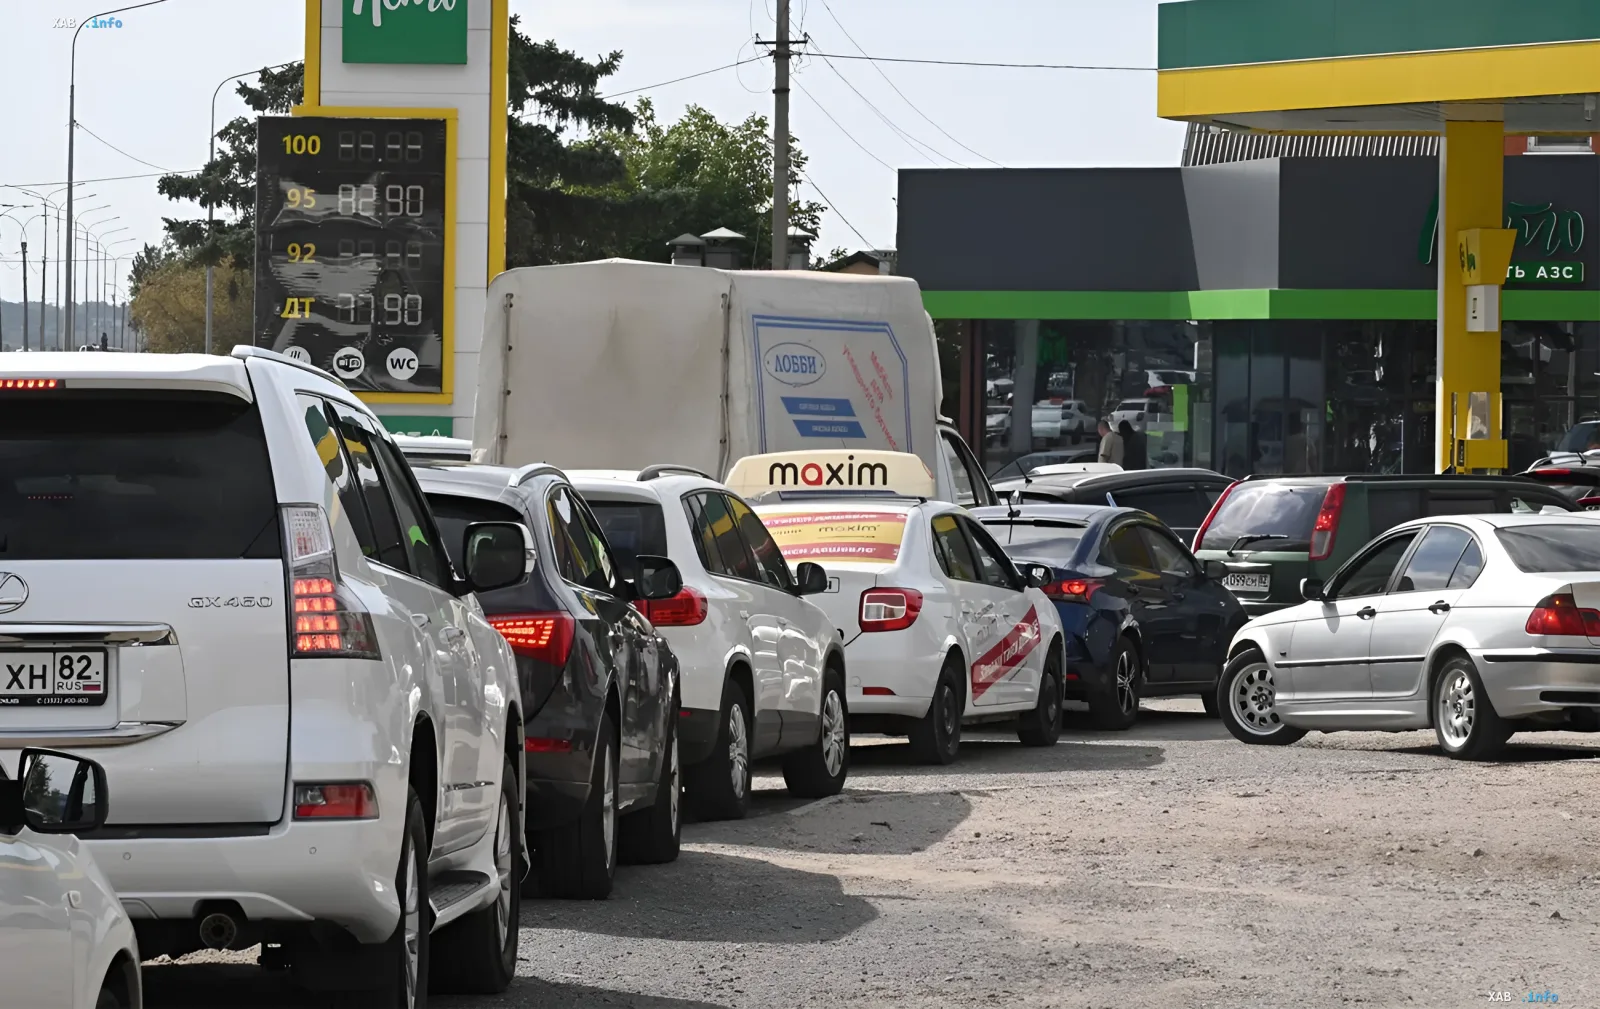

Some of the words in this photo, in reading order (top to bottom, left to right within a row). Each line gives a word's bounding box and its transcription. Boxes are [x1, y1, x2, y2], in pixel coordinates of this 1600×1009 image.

[282, 134, 321, 155] 100
[287, 188, 316, 209] 95
[287, 243, 316, 264] 92
[1536, 266, 1574, 279] АЗС
[280, 297, 316, 319] ДТ
[390, 358, 416, 370] WC
[775, 354, 818, 374] ЛОББИ
[769, 454, 888, 486] maxim
[818, 523, 877, 533] maxim
[187, 597, 222, 609] GX
[223, 596, 273, 609] 460
[59, 654, 92, 680] 82
[57, 681, 82, 691] RUS
